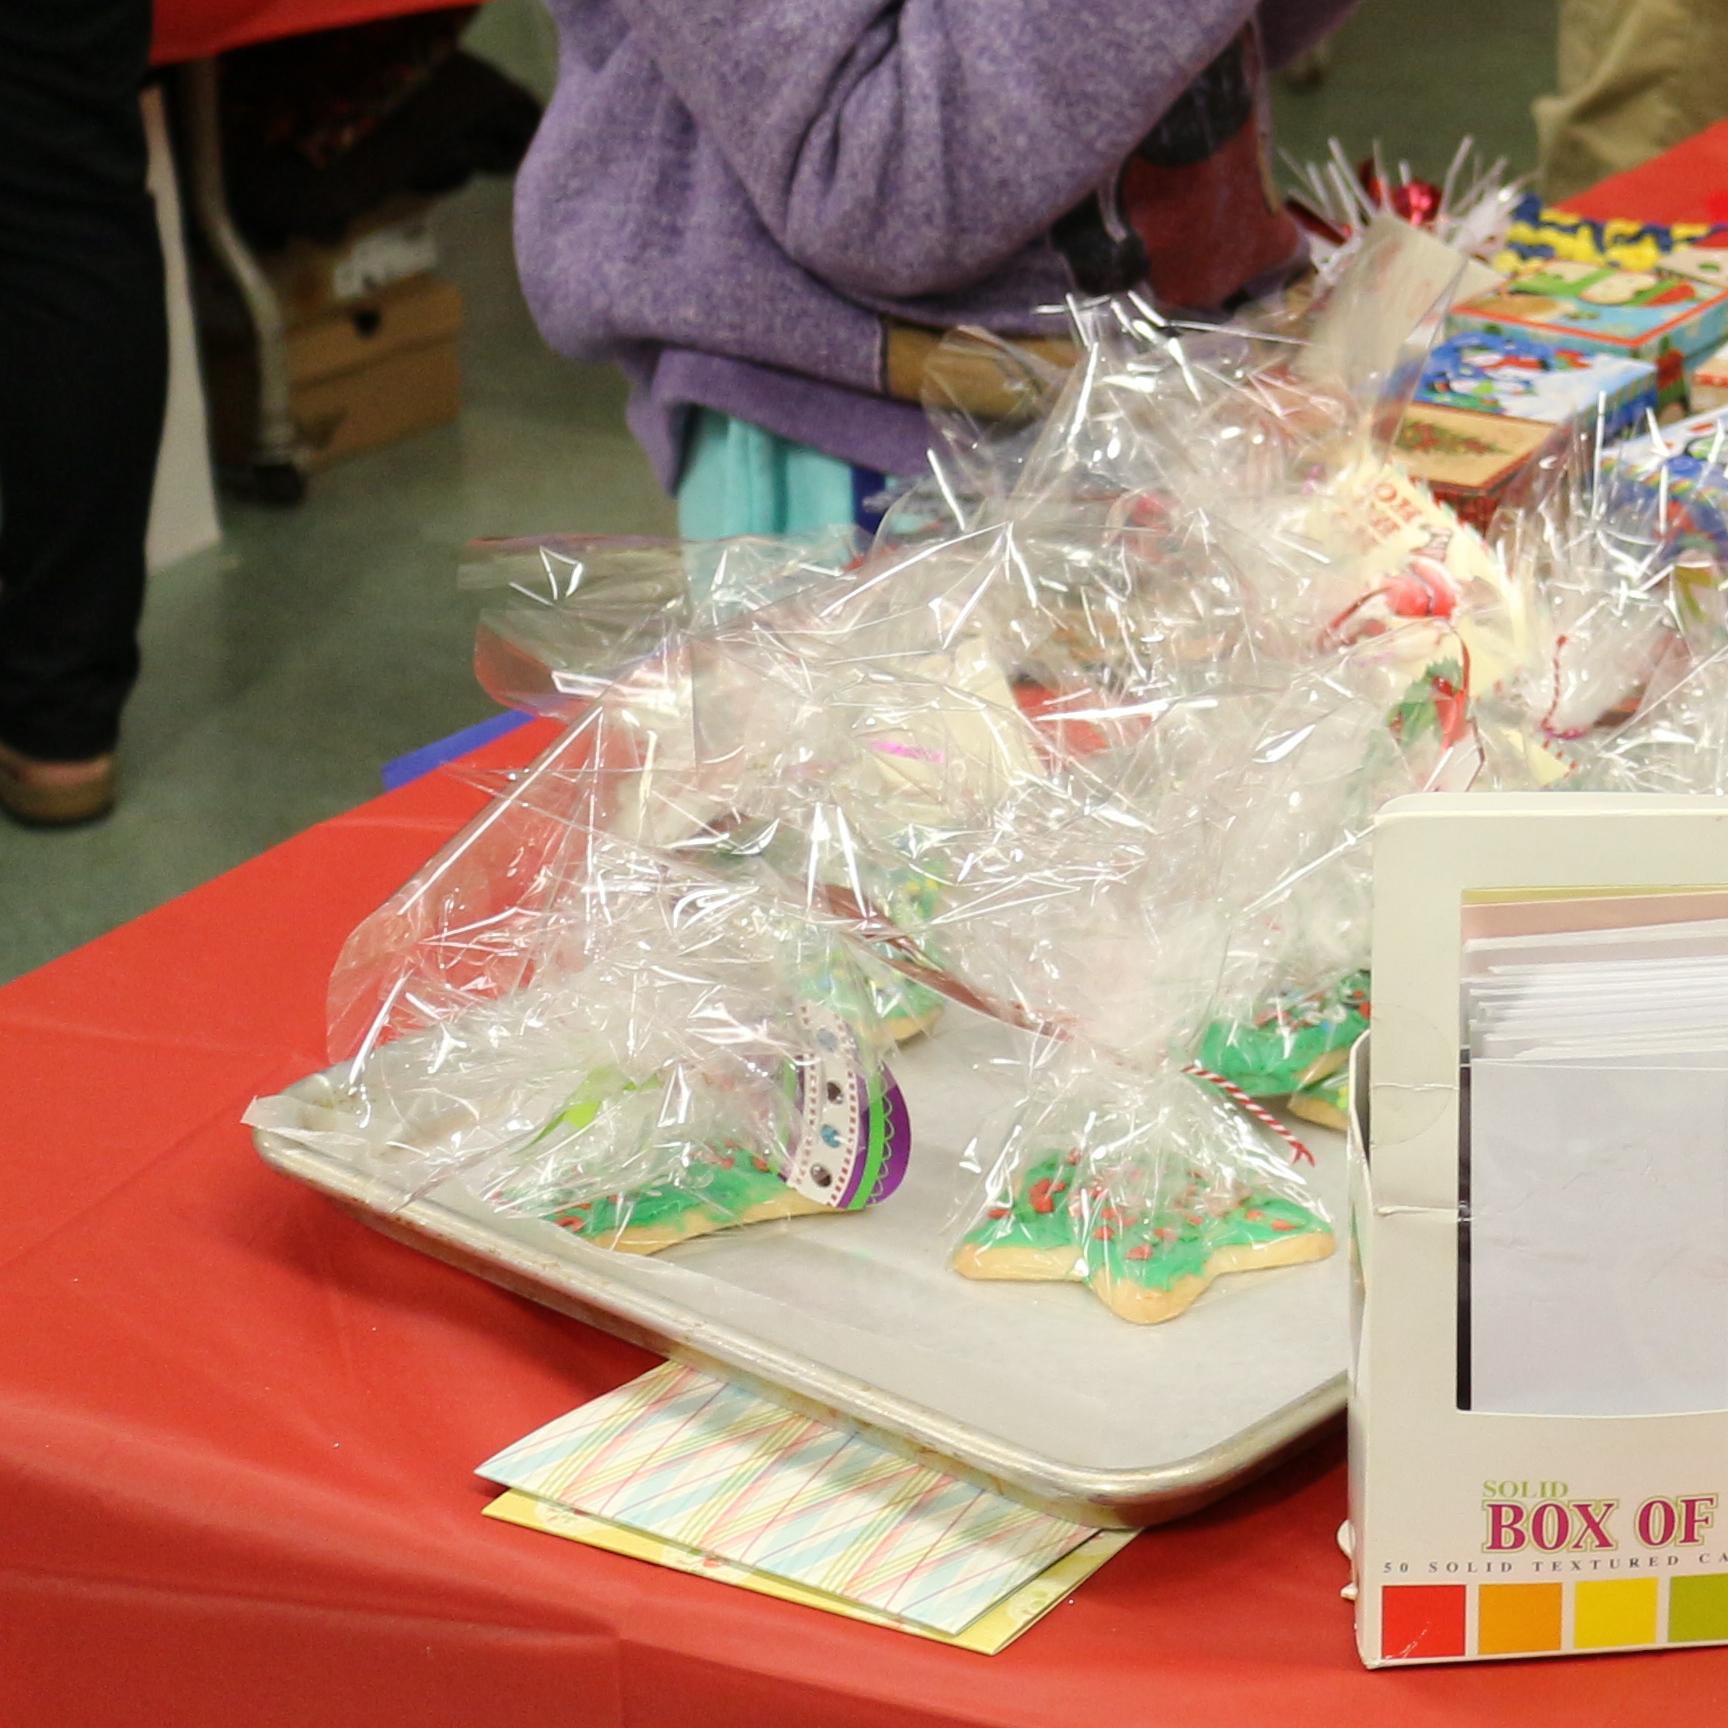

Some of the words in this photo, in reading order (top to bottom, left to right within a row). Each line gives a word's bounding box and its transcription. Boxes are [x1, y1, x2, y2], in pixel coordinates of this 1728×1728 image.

[1483, 1479, 1569, 1499] SOLID
[1483, 1499, 1618, 1553] BOX
[1635, 1494, 1718, 1548] OF
[1383, 1561, 1409, 1574] 50
[1428, 1561, 1513, 1574] SOLID
[1532, 1554, 1680, 1573] TEXTURED
